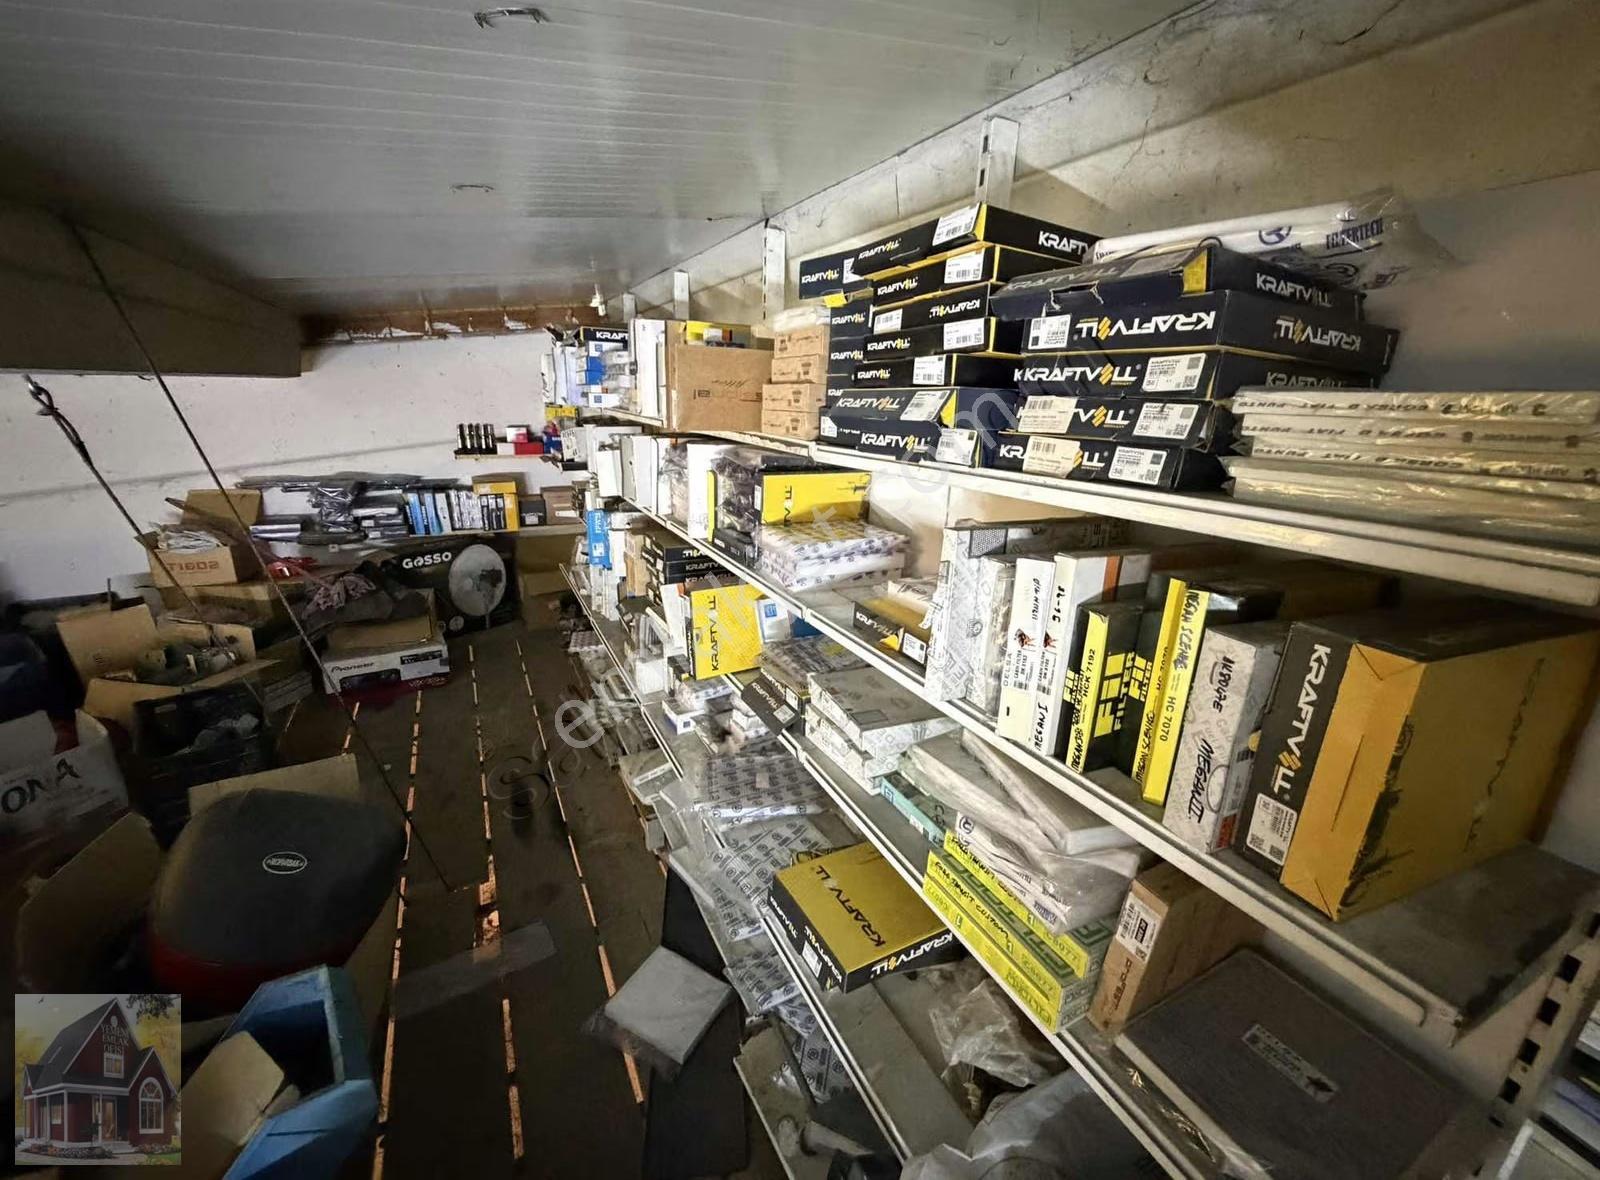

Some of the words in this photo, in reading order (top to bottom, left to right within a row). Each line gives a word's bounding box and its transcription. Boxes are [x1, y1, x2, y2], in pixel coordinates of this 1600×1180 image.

[1086, 648, 1096, 676] 7192
[1166, 695, 1177, 712] HC
[1160, 711, 1173, 742] 7070
